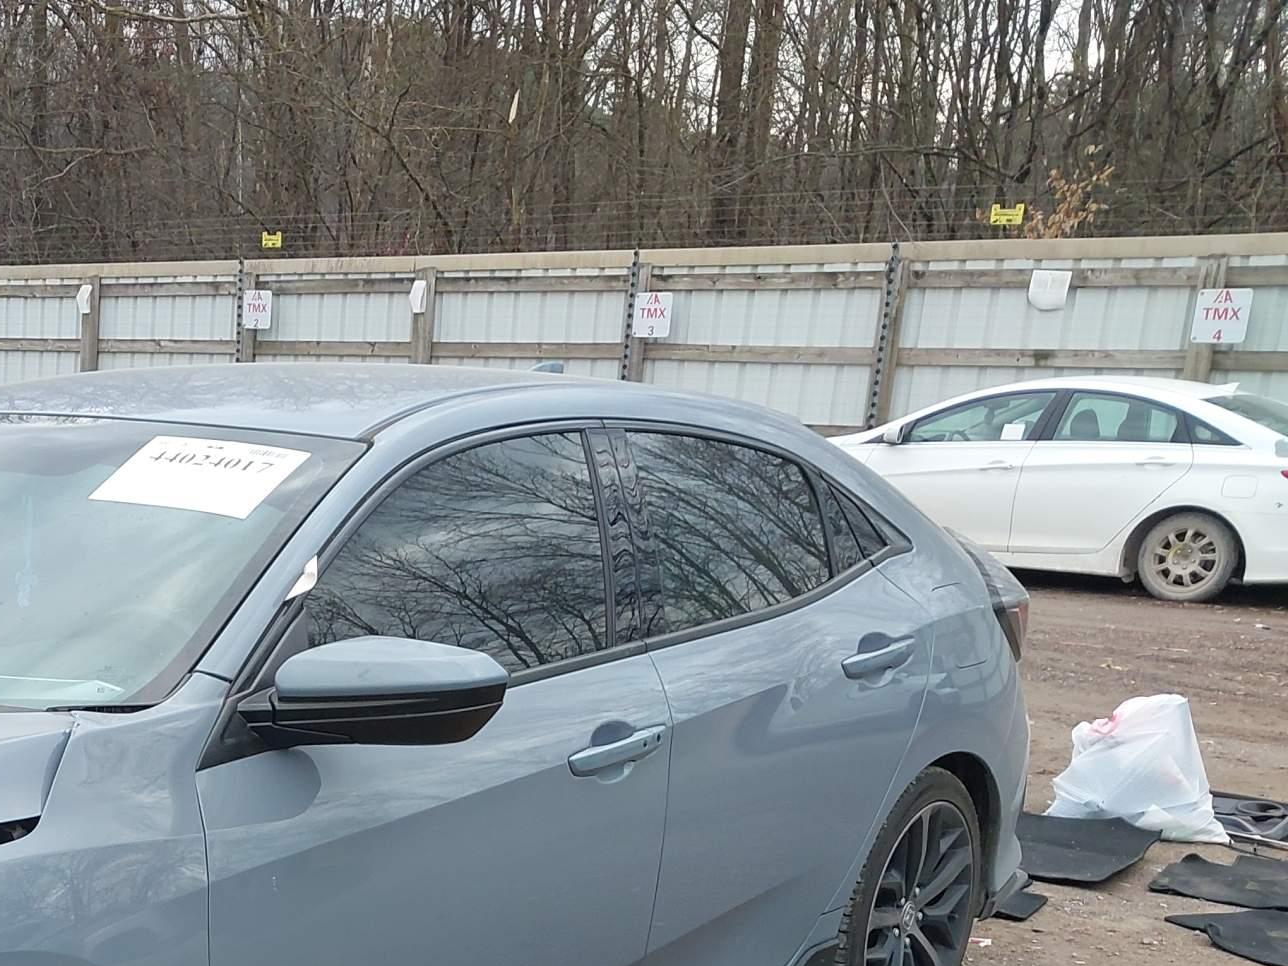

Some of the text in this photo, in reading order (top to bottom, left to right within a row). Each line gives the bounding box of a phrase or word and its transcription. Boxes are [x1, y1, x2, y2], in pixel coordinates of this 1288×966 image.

[247, 303, 268, 313] TMX
[639, 308, 667, 319] TMX
[1202, 307, 1242, 320] TMX
[647, 325, 655, 336] 3
[1212, 329, 1222, 342] 4
